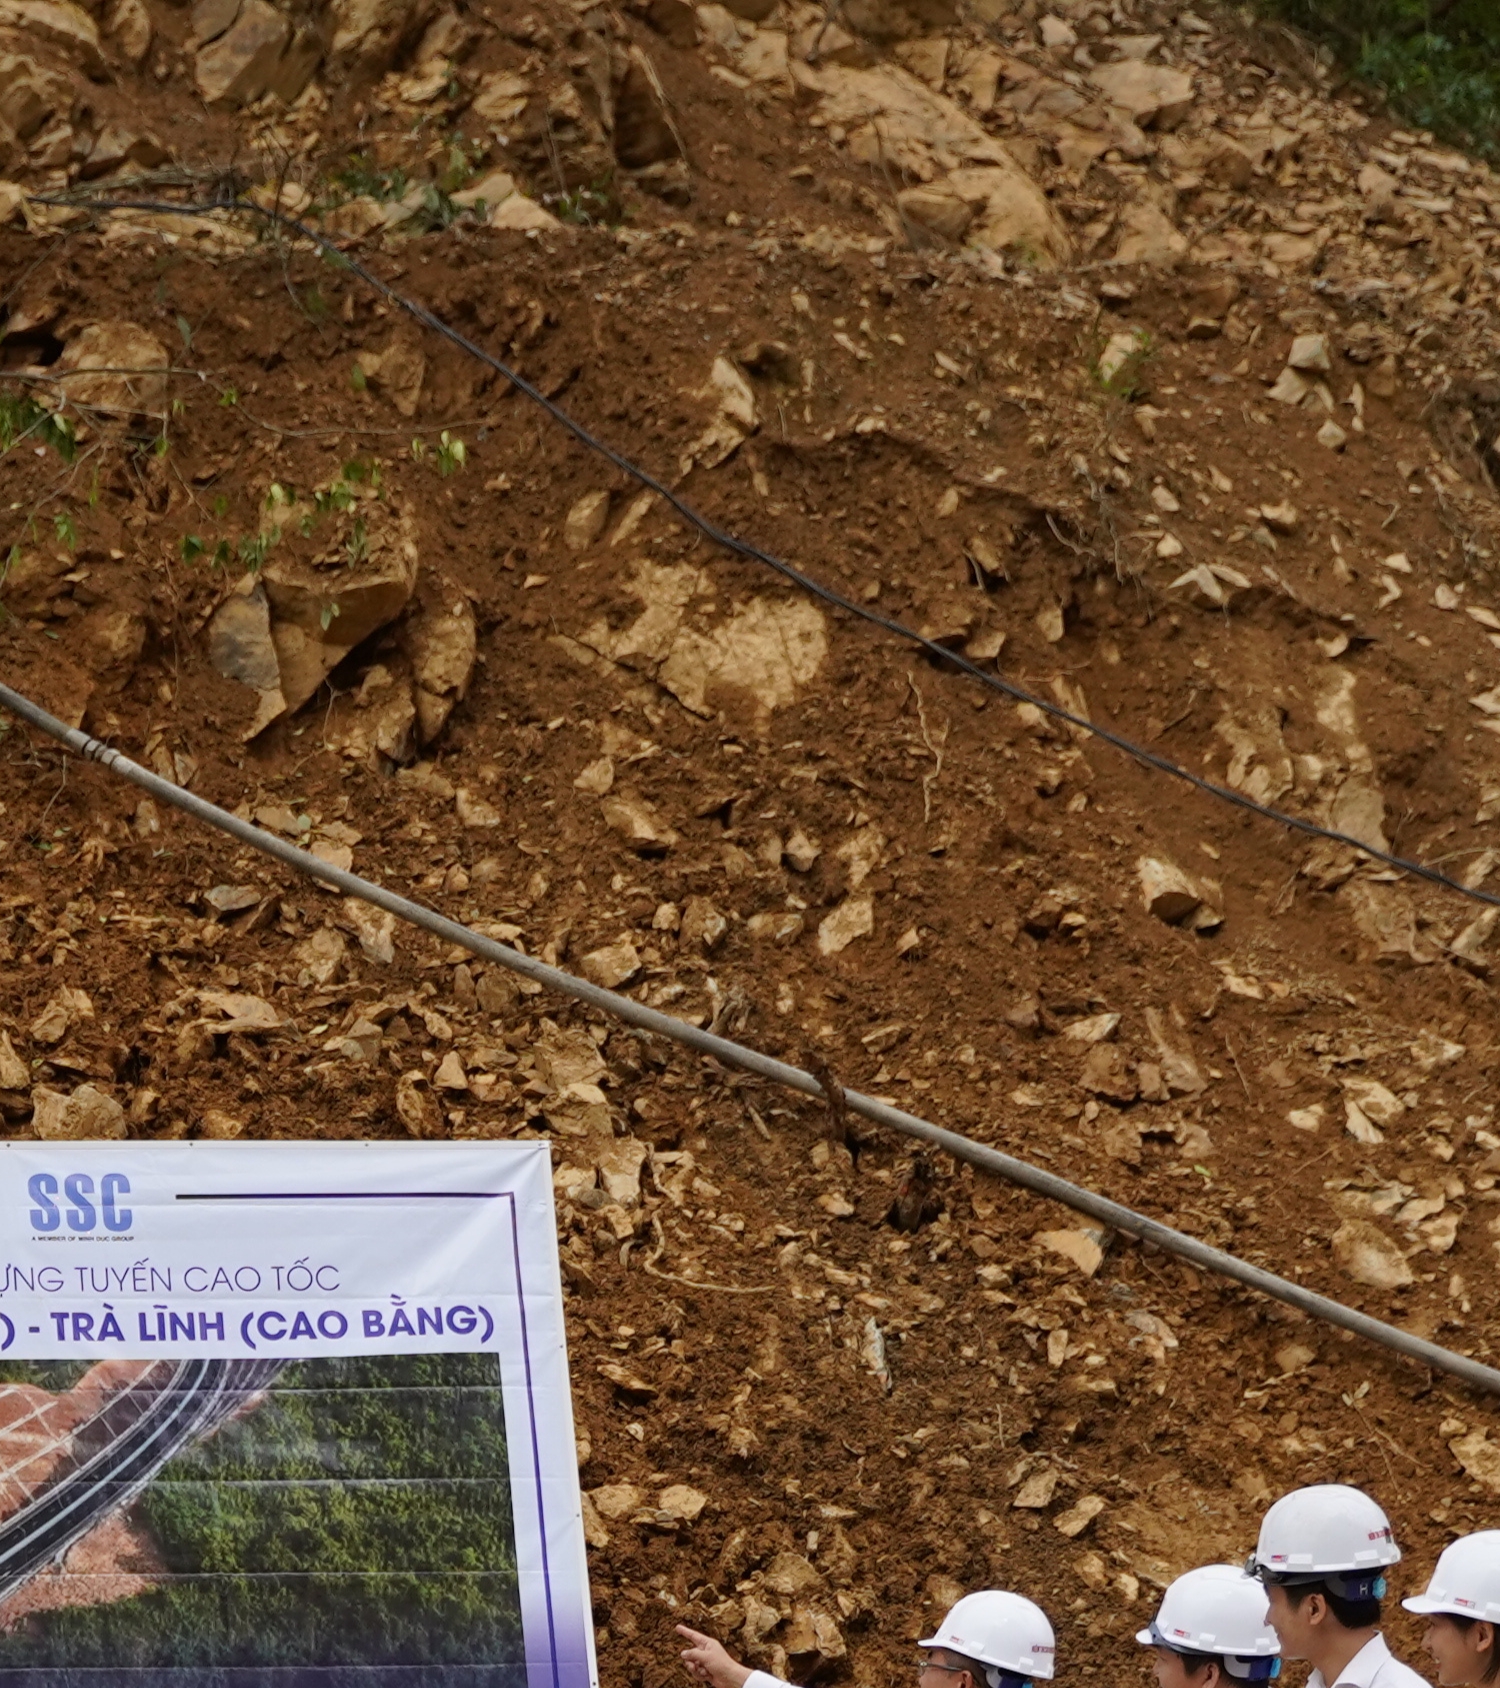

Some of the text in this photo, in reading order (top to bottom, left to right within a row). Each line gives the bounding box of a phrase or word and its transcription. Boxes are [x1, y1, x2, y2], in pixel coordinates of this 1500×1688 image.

[28, 1173, 132, 1232] SSC
[75, 1258, 171, 1293] TUYẾN
[184, 1265, 261, 1292] CAO
[271, 1257, 341, 1291] TỐC
[28, 1325, 40, 1333] -
[50, 1303, 125, 1342] TRÀ
[139, 1304, 225, 1342] LĨNH
[240, 1309, 348, 1349] (CAO
[363, 1294, 494, 1344] BẰNG)
